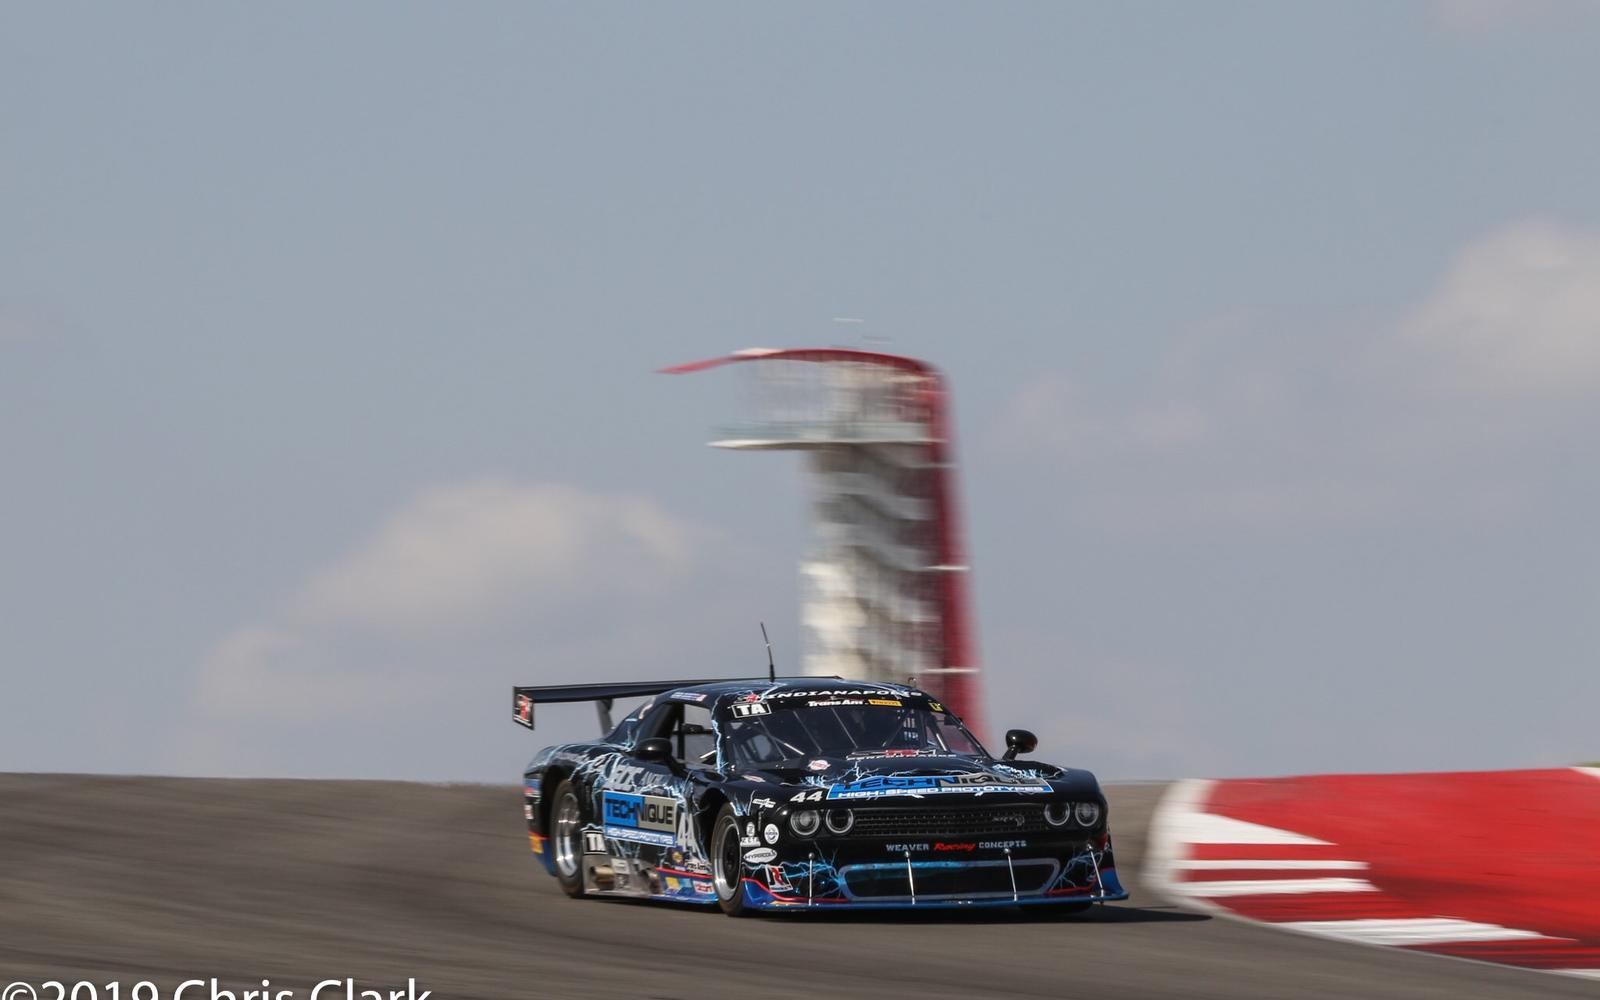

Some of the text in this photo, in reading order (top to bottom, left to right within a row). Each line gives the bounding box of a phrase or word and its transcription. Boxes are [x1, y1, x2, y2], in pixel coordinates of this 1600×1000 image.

[737, 704, 766, 715] TA
[790, 791, 823, 803] 44
[838, 785, 1044, 798] HIGH-SPEED PROTOTYPES
[605, 798, 673, 825] TECHNIQUE
[677, 812, 699, 856] 44
[886, 840, 1027, 852] WEAVER Racing CONCEPTS
